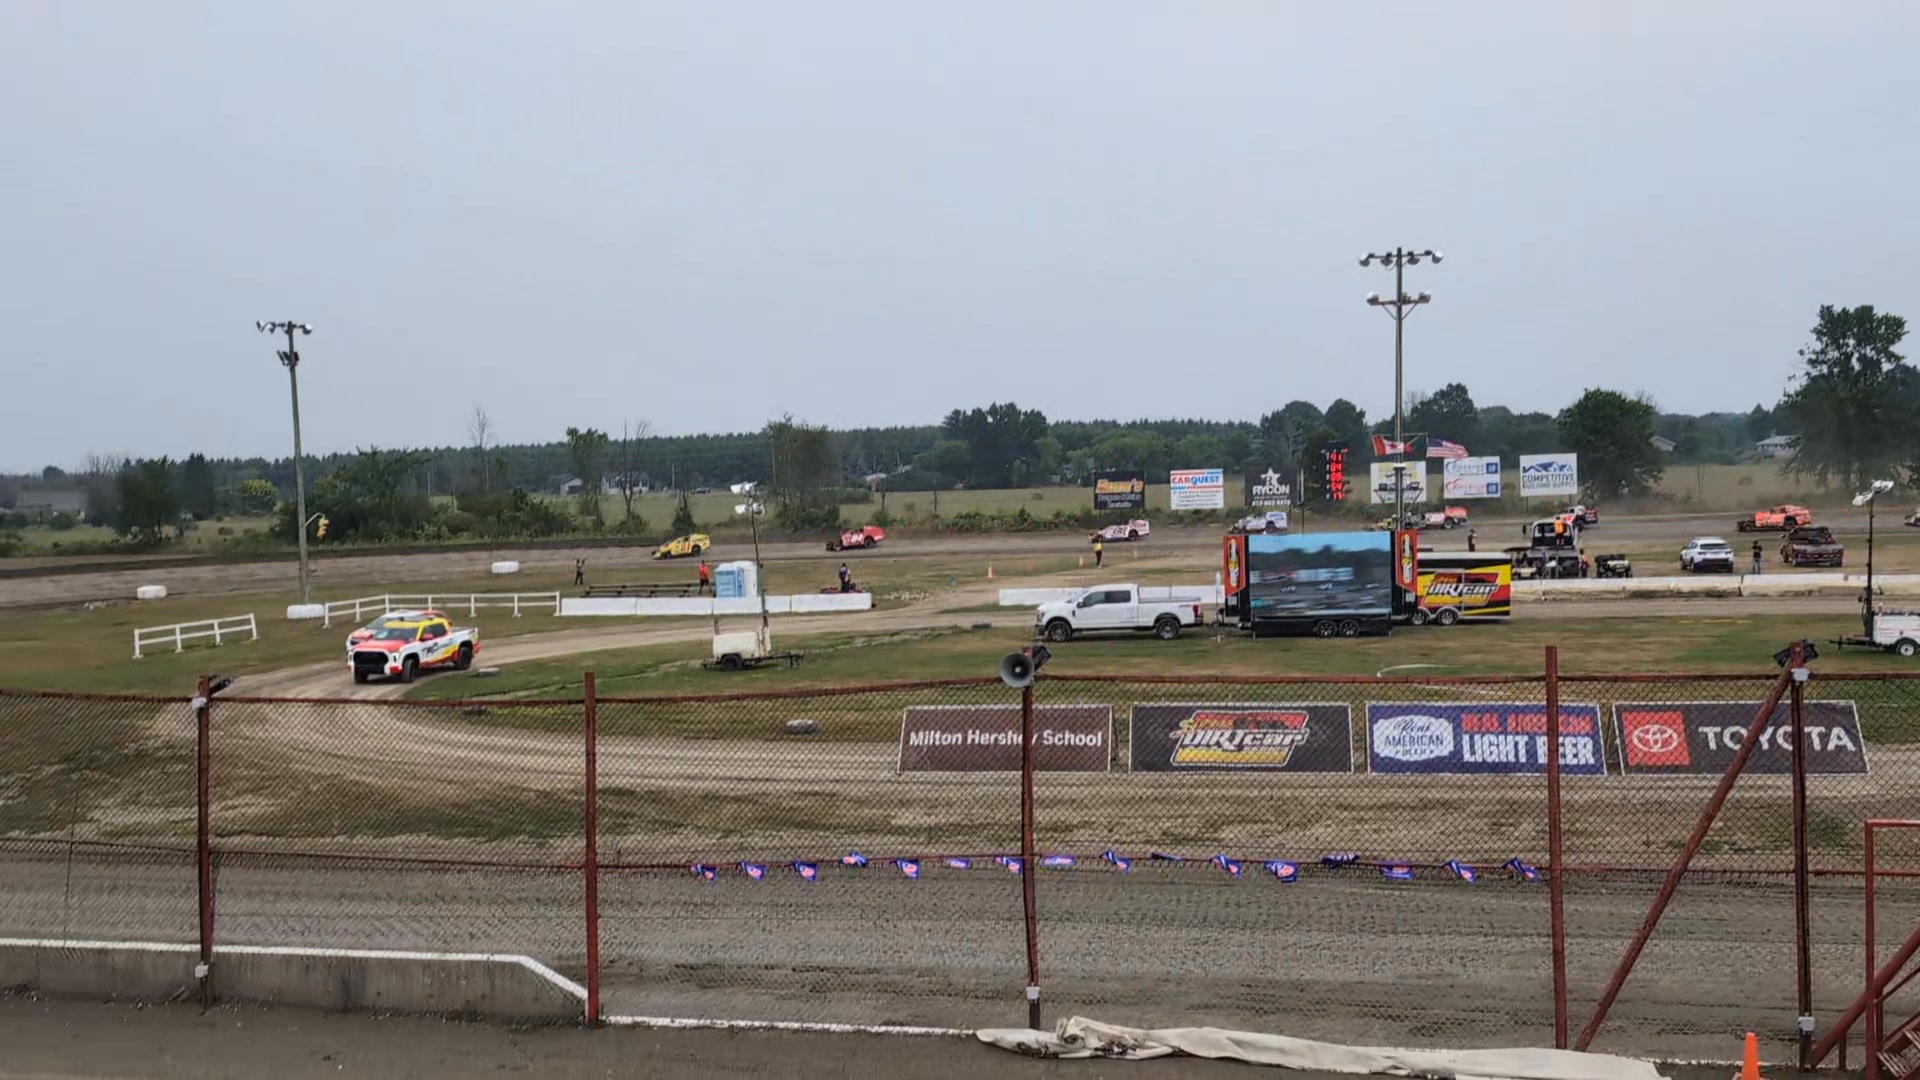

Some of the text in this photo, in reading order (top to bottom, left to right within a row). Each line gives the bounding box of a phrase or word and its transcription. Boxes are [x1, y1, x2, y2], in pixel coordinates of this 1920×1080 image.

[1172, 475, 1220, 485] CARQUEST
[1522, 473, 1574, 483] COMPETITIVE
[1252, 484, 1290, 496] RYCON
[1507, 713, 1594, 735] AMERCAN
[909, 729, 1103, 748] Milton Hersh School
[1384, 734, 1444, 748] AMERICAN
[1698, 725, 1856, 751] TOYOTA
[1462, 733, 1528, 763] LIGHT
